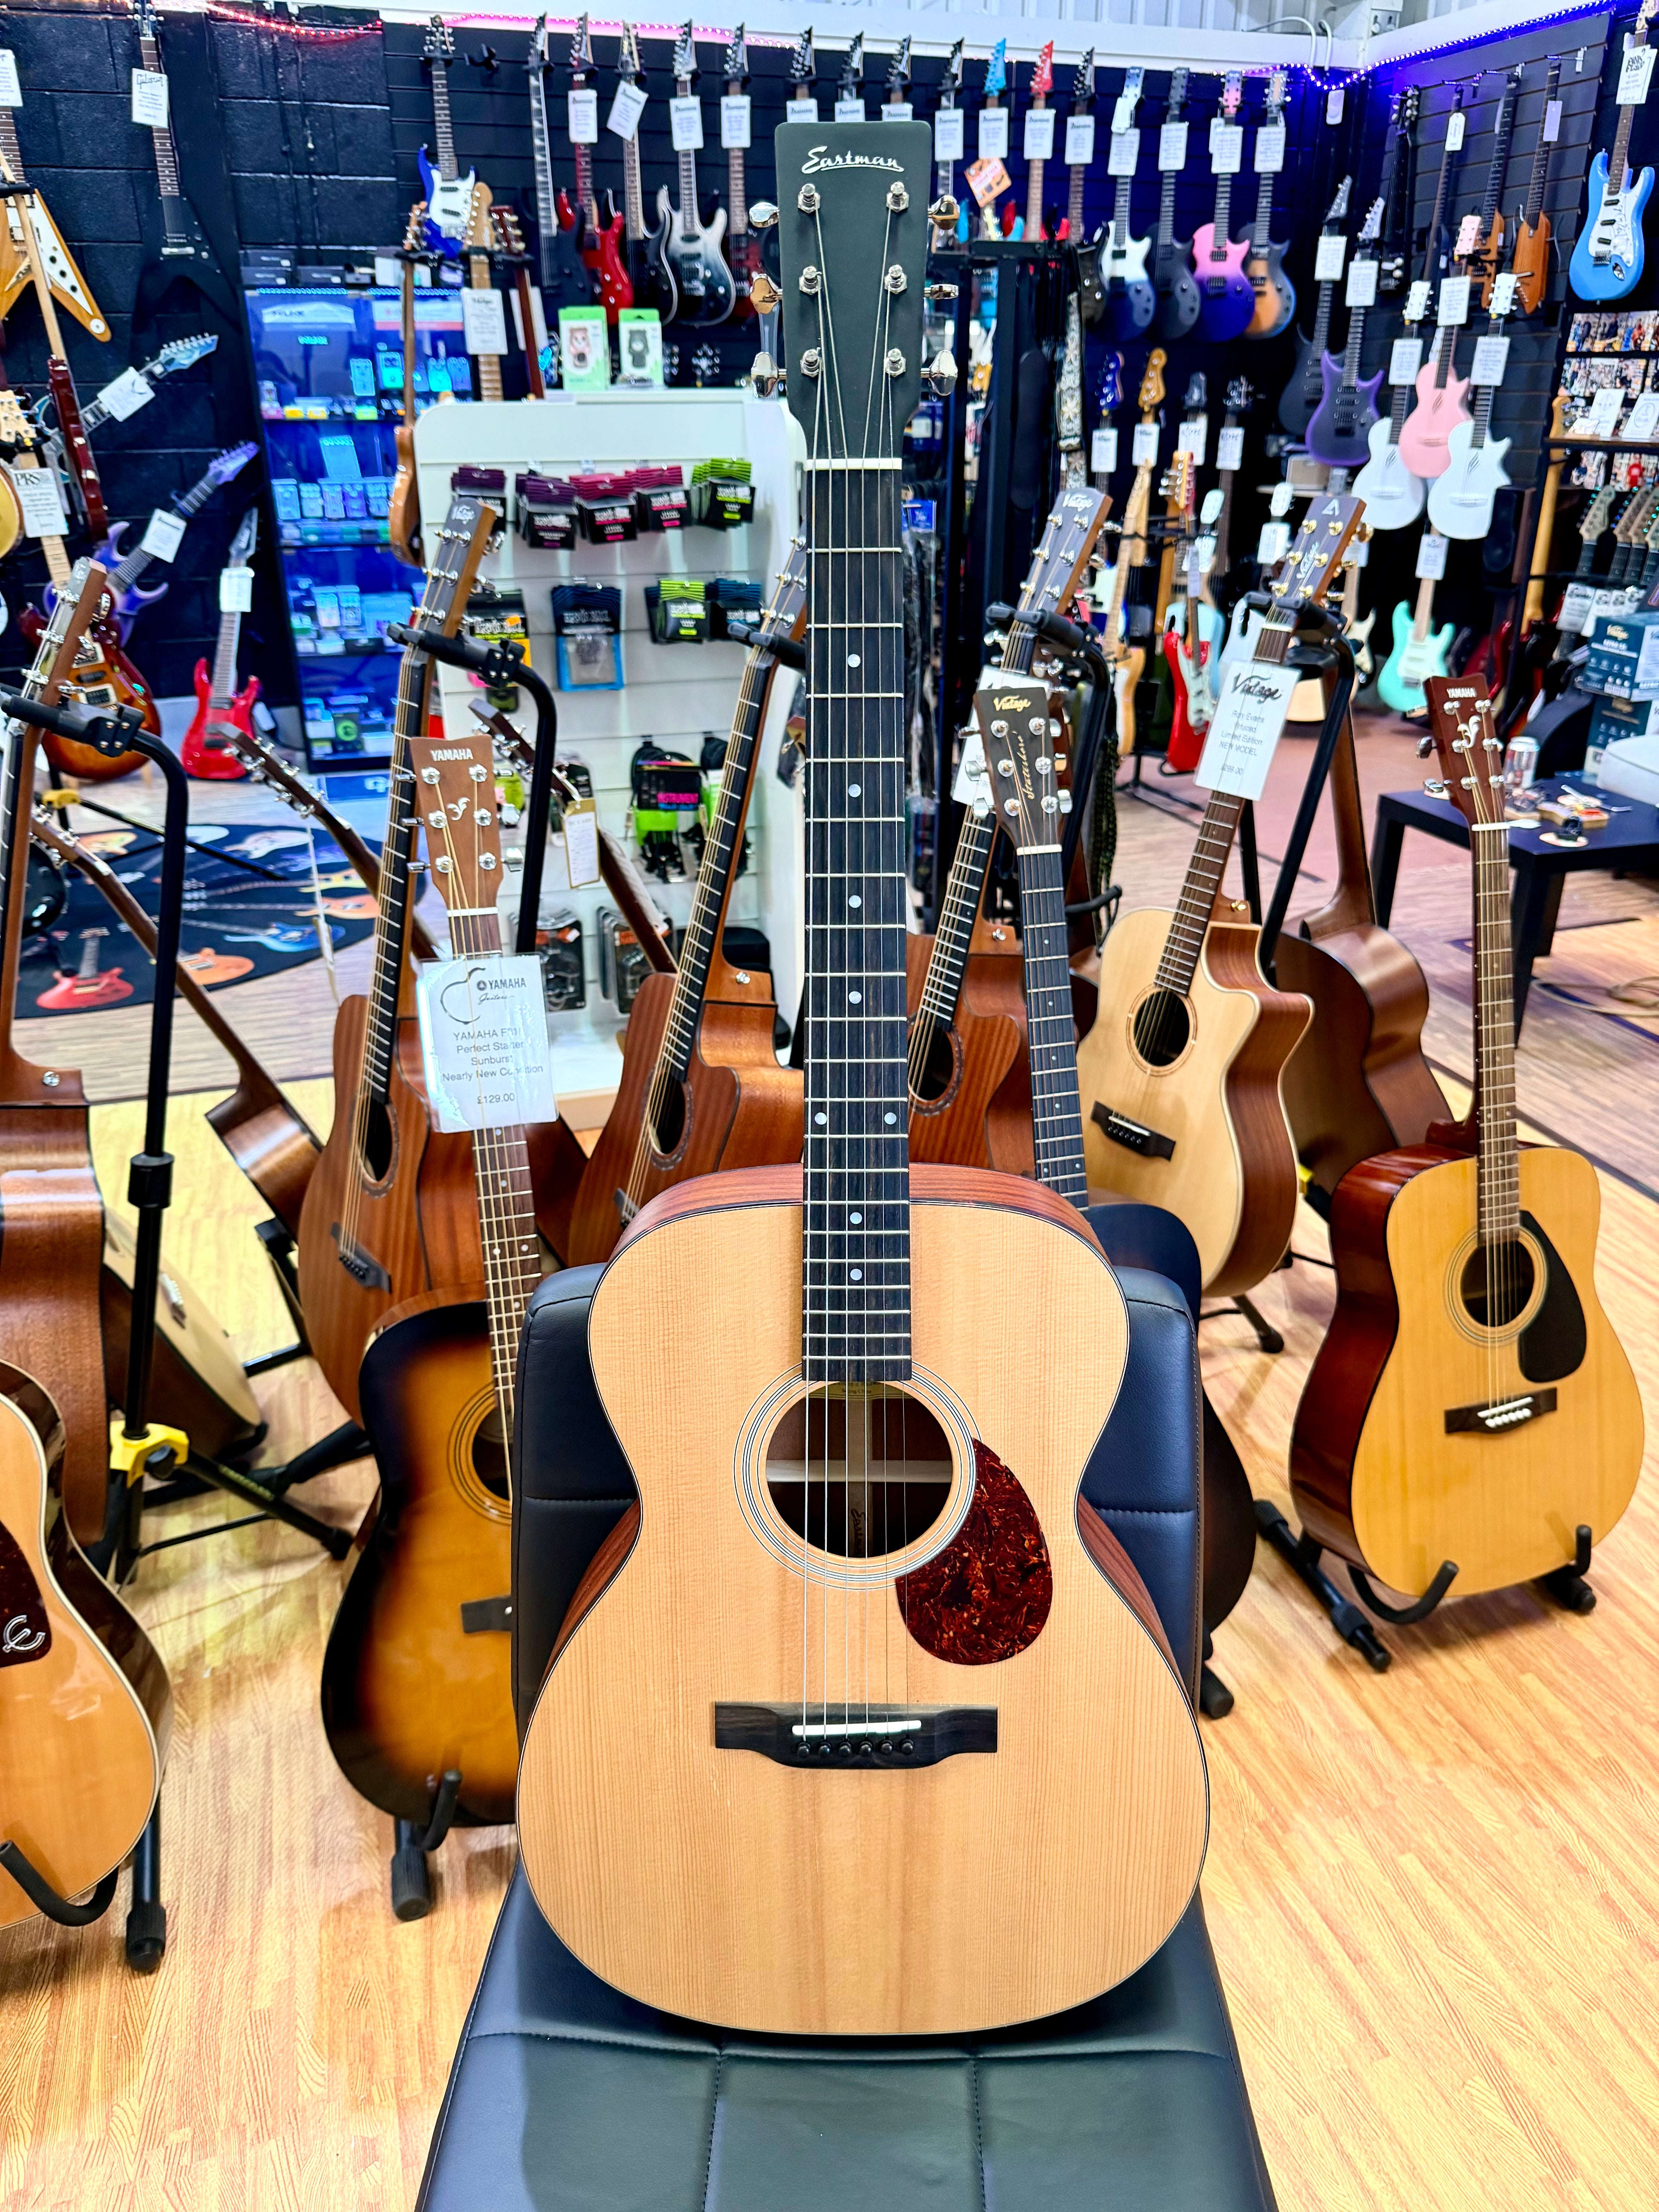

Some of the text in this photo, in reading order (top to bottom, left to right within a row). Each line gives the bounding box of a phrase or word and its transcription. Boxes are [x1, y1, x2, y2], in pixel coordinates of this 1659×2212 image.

[802, 146, 904, 174] Eastman
[1231, 673, 1283, 704] Vintage
[1447, 687, 1477, 698] YAMAHA
[993, 695, 1032, 712] Vintage
[430, 748, 474, 762] YAMAHA
[488, 977, 527, 990] YAMAHA
[453, 1029, 498, 1041] YAMAHA
[457, 1043, 491, 1054] Perfect
[442, 1071, 473, 1082] Nearly
[476, 1069, 497, 1078] New
[477, 1092, 515, 1104] £129.00
